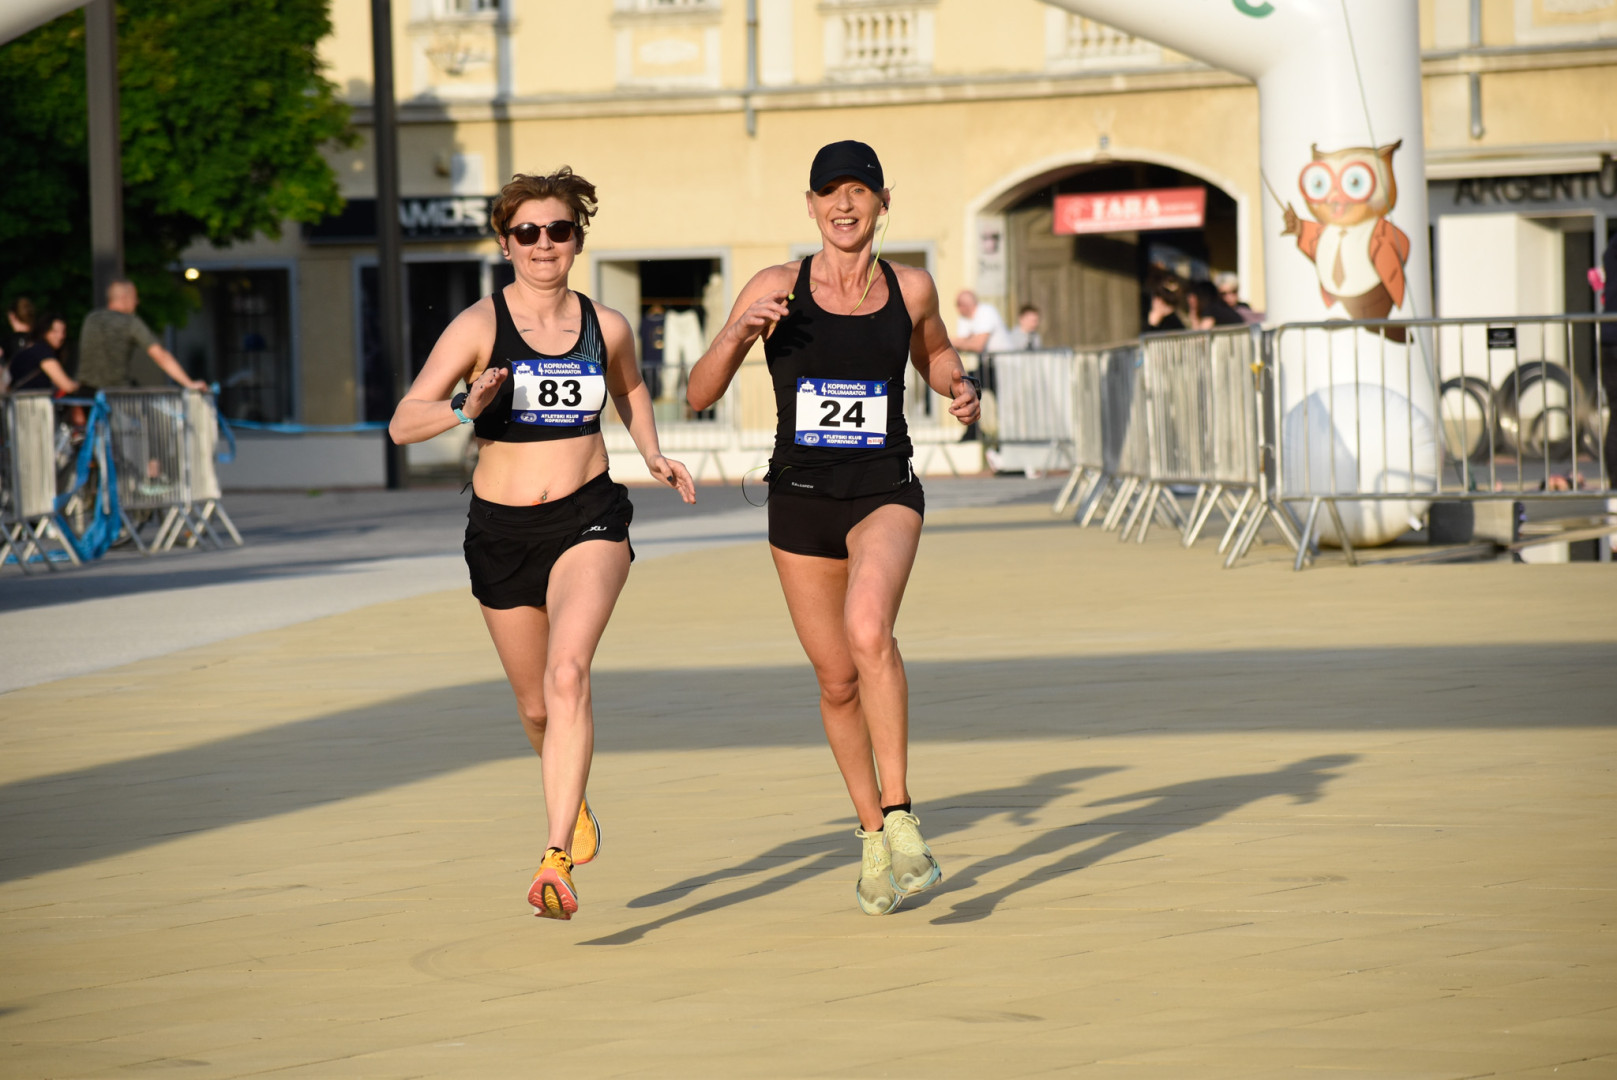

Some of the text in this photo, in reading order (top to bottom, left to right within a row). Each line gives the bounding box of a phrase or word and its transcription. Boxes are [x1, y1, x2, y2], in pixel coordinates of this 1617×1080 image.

[538, 379, 582, 407] 83
[827, 383, 867, 391] KOPRIVNIČKI
[819, 400, 866, 428] 24
